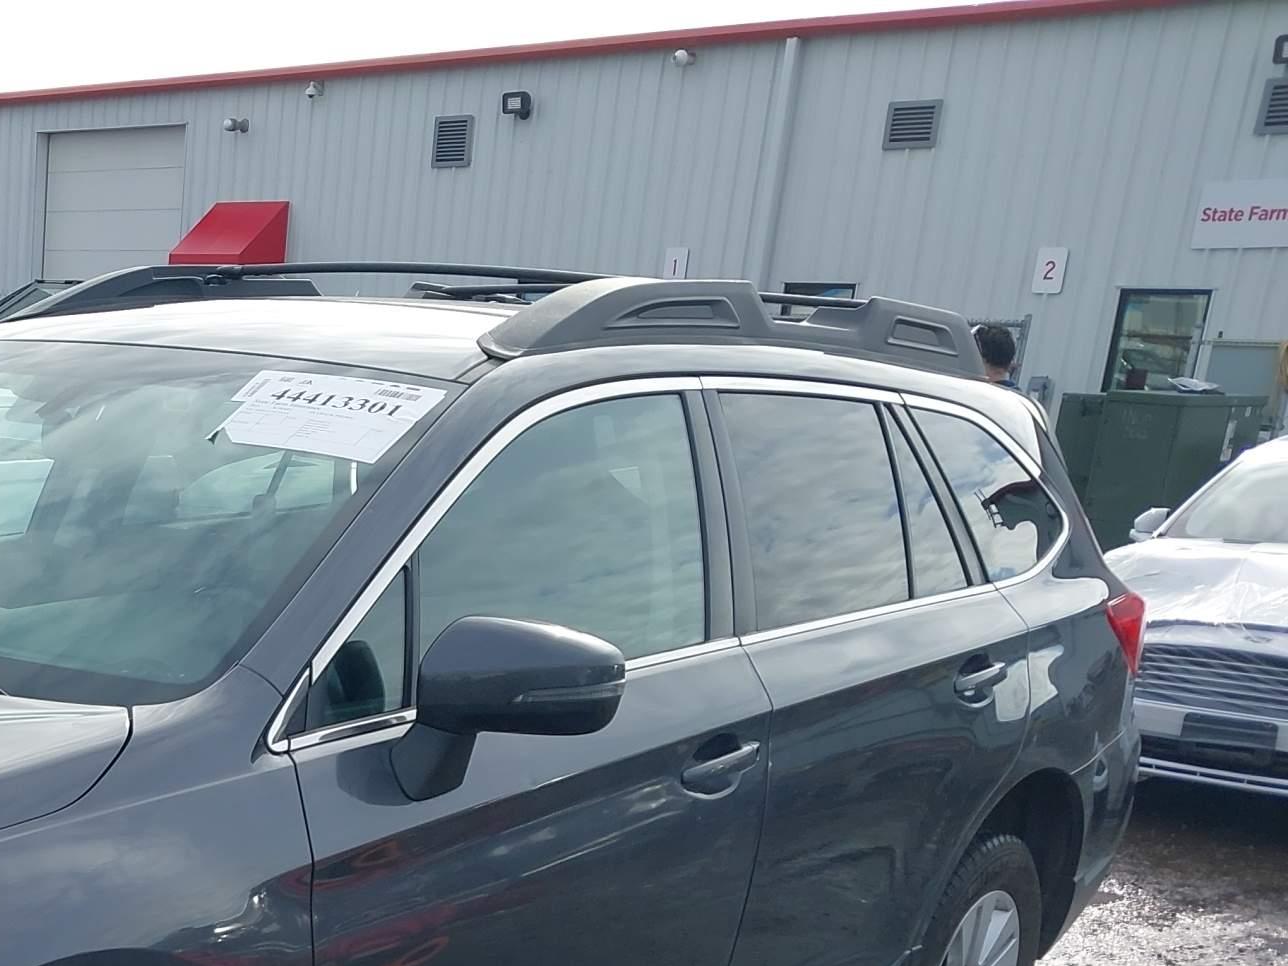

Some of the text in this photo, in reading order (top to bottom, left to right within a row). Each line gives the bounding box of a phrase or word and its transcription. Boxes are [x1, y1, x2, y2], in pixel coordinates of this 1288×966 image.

[1201, 207, 1244, 222] State
[1043, 260, 1056, 281] 2
[270, 387, 403, 417] 44413301
